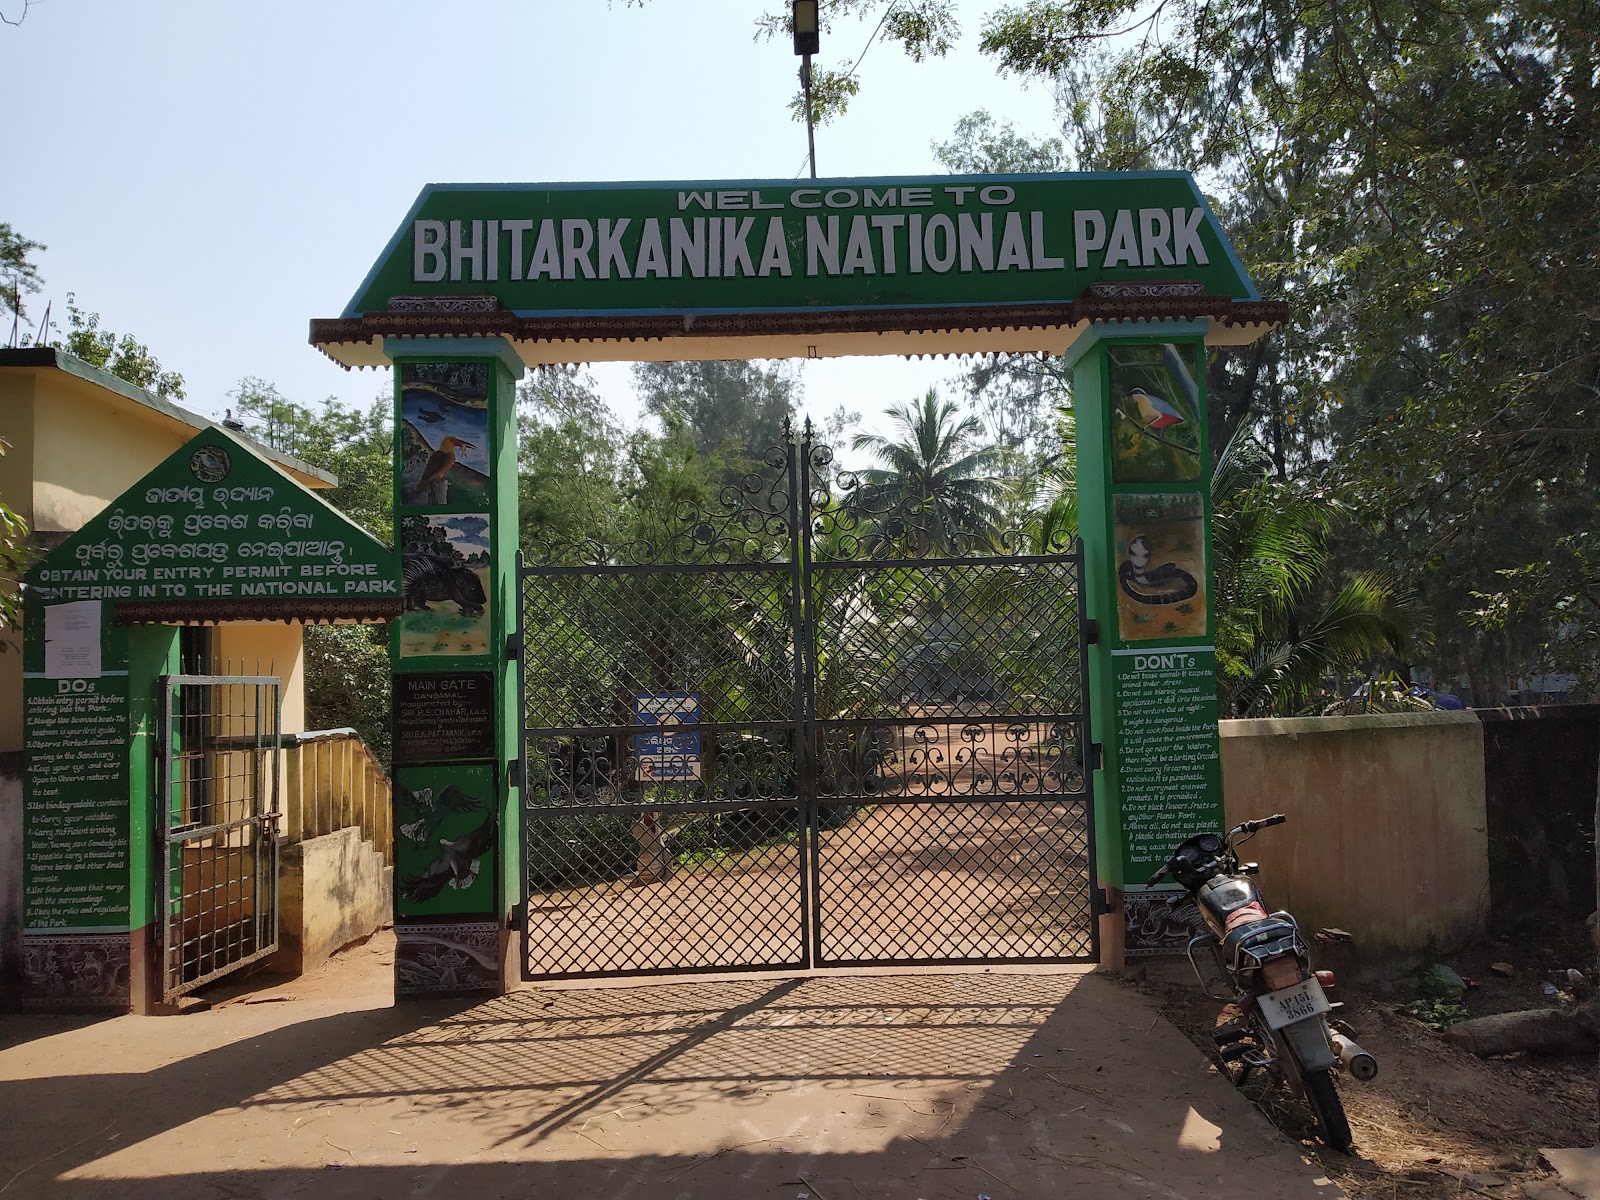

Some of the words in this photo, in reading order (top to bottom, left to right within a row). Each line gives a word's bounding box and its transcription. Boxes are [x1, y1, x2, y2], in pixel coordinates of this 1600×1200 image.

[677, 187, 934, 211] WELCOME
[944, 185, 1016, 206] TO
[413, 216, 793, 283] BHITARKANIKA
[805, 210, 1065, 277] NATIONAL
[1073, 207, 1210, 269] PARK
[39, 568, 99, 582] OBTAIN
[102, 568, 147, 581] YOUR
[153, 566, 215, 580] ENTRY
[222, 565, 293, 579] PERMIT
[300, 563, 379, 577] BEFORE
[138, 584, 156, 598] IN
[161, 584, 187, 597] TO
[193, 583, 233, 597] THE
[240, 580, 339, 596] NATIONAL
[344, 579, 397, 594] PARK
[1134, 654, 1196, 671] DON'Ts
[58, 679, 95, 693] DOs
[409, 681, 435, 691] MAIN
[441, 680, 476, 690] GATE
[75, 695, 100, 707] permit
[100, 695, 124, 703] before
[1129, 718, 1144, 728] might
[60, 727, 65, 735] is
[1145, 747, 1153, 757] go
[1141, 755, 1157, 765] might
[1174, 753, 1196, 763] lurking
[52, 765, 70, 774] your
[72, 765, 84, 773] eye
[1144, 766, 1161, 776] carry
[64, 816, 83, 826] your
[1196, 819, 1218, 830] plastic
[1136, 846, 1147, 854] may
[65, 853, 82, 862] carry
[1130, 854, 1151, 862] hazard
[89, 883, 103, 891] that
[80, 906, 92, 914] and
[29, 919, 37, 927] of
[38, 919, 48, 927] the
[1286, 1002, 1315, 1020] 3866
